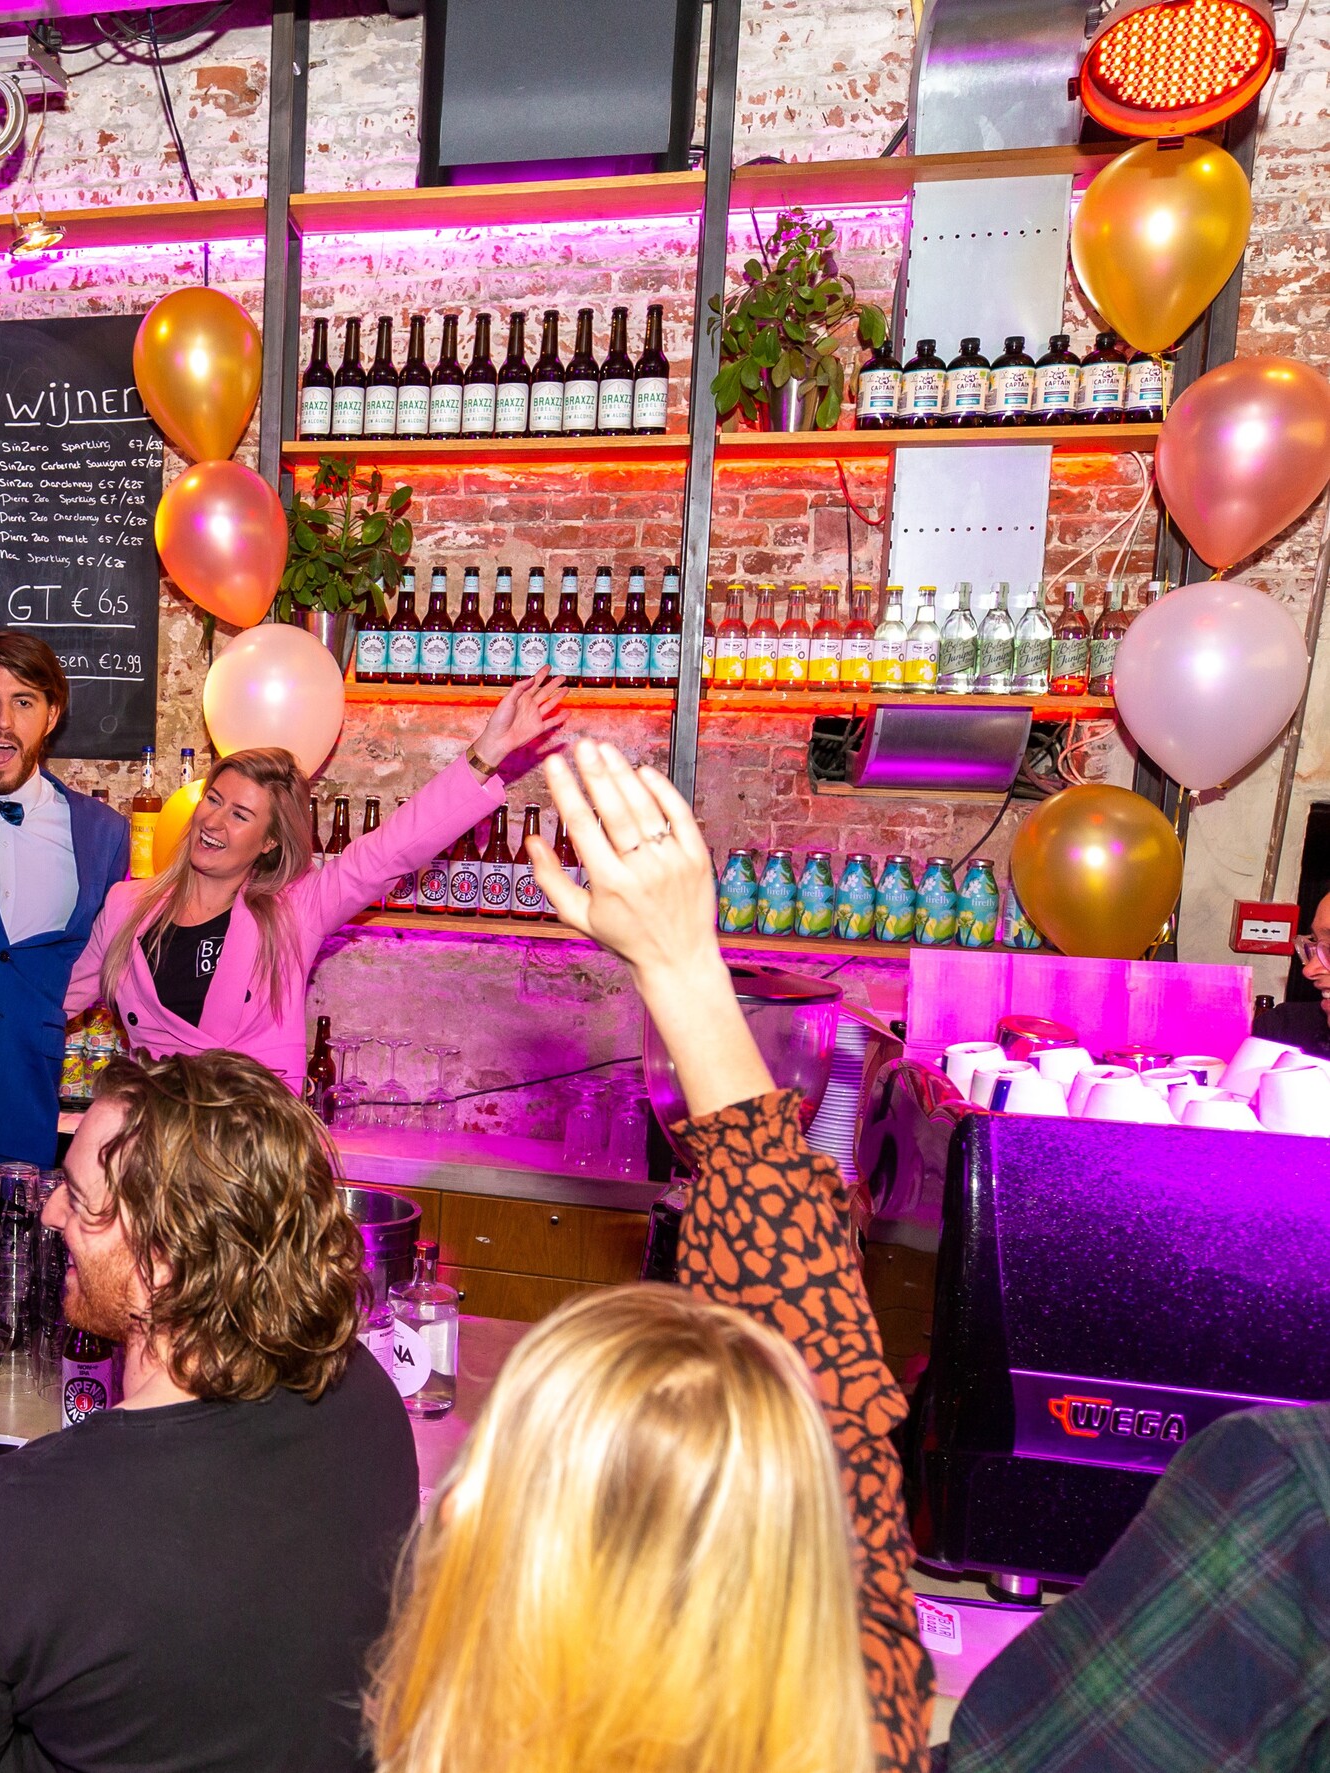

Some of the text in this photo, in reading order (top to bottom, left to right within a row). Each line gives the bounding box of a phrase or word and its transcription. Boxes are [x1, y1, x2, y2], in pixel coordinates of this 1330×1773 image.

[8, 585, 62, 621] GT
[99, 653, 142, 673] €2,99
[727, 886, 750, 894] firefly
[766, 888, 790, 897] firefly
[802, 889, 826, 899] firefly
[850, 891, 872, 900] firefly
[885, 893, 909, 902] firefly
[926, 895, 950, 905] firefly
[972, 898, 995, 906] firefly
[66, 1381, 101, 1400] JOPEN
[1071, 1402, 1186, 1443] WEGA
